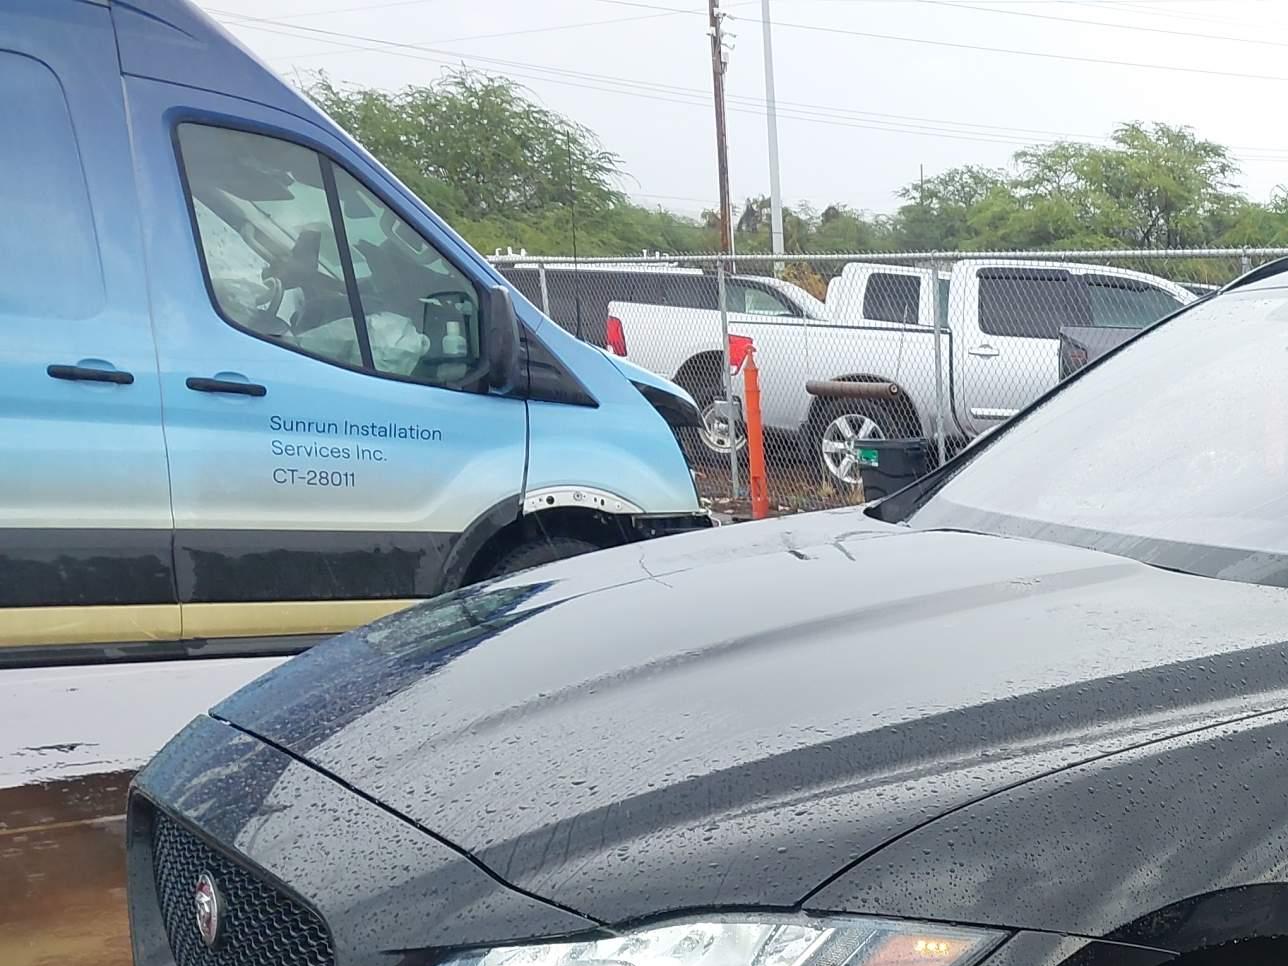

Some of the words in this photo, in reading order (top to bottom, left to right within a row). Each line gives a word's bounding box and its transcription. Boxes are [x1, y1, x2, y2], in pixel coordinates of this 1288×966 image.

[270, 415, 338, 434] Sunrun
[344, 421, 442, 441] Installation
[271, 440, 350, 459] Services
[356, 445, 388, 461] Inc.
[273, 468, 355, 487] CT-28011
